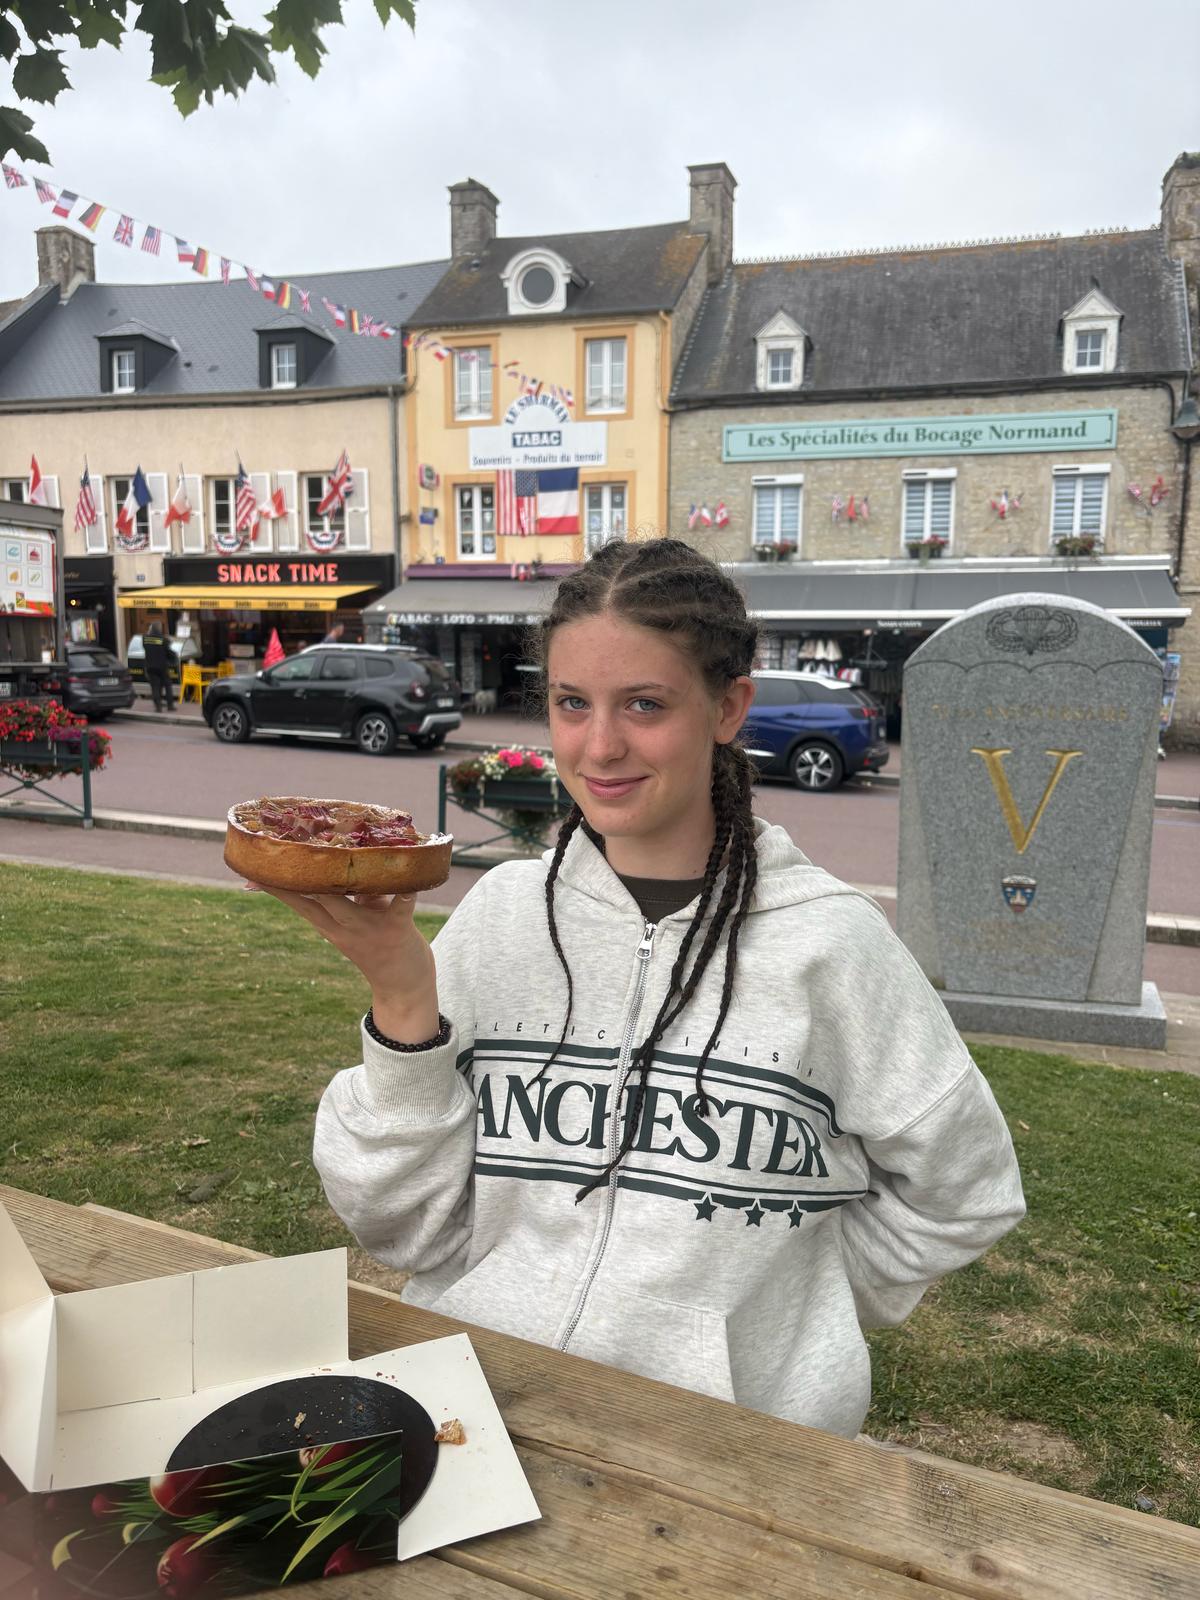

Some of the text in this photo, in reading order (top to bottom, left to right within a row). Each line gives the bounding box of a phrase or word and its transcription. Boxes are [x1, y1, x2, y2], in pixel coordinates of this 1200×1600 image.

[505, 410, 519, 425] LE
[514, 432, 560, 446] TABAC
[748, 420, 1088, 451] Les Spécialités du Bocage Normand
[473, 455, 512, 466] Souvenirs
[523, 453, 558, 463] Produits
[561, 452, 572, 462] du
[574, 453, 603, 462] terroir
[217, 563, 338, 582] SNACK TIME
[391, 613, 431, 624] TABAC
[443, 614, 475, 624] LOTO
[487, 614, 514, 624] PMU
[971, 748, 1083, 855] V
[473, 1073, 830, 1178] ANCHESTER
